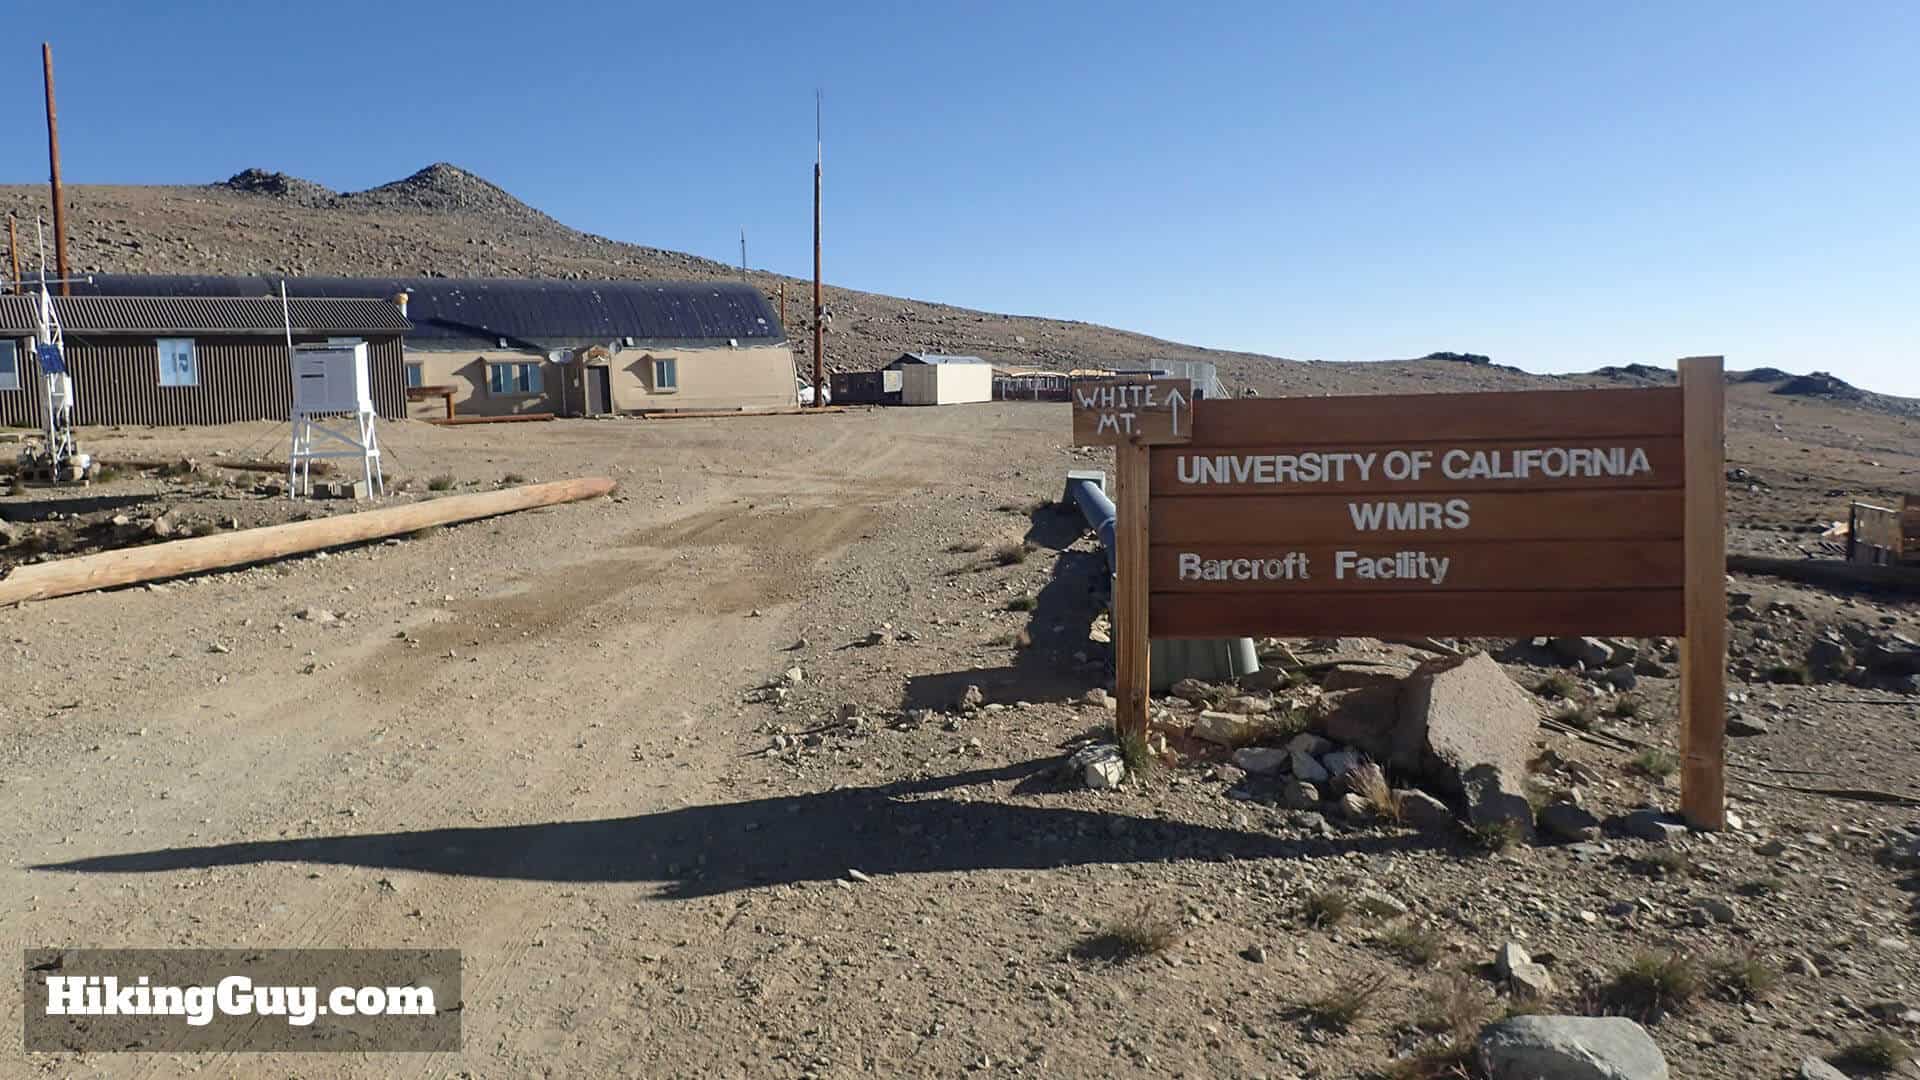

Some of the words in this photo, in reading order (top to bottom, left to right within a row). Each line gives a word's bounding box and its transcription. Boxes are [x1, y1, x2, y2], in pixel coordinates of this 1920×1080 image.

[1076, 384, 1158, 409] WHITE
[1097, 412, 1142, 436] MT.
[1176, 452, 1378, 485] UNIVERSITY
[1383, 449, 1433, 481] OF
[1441, 447, 1651, 480] CALIFORNIA
[1348, 499, 1471, 532] WMRS
[1178, 551, 1310, 582] Barcroft
[1334, 550, 1450, 585] Facility
